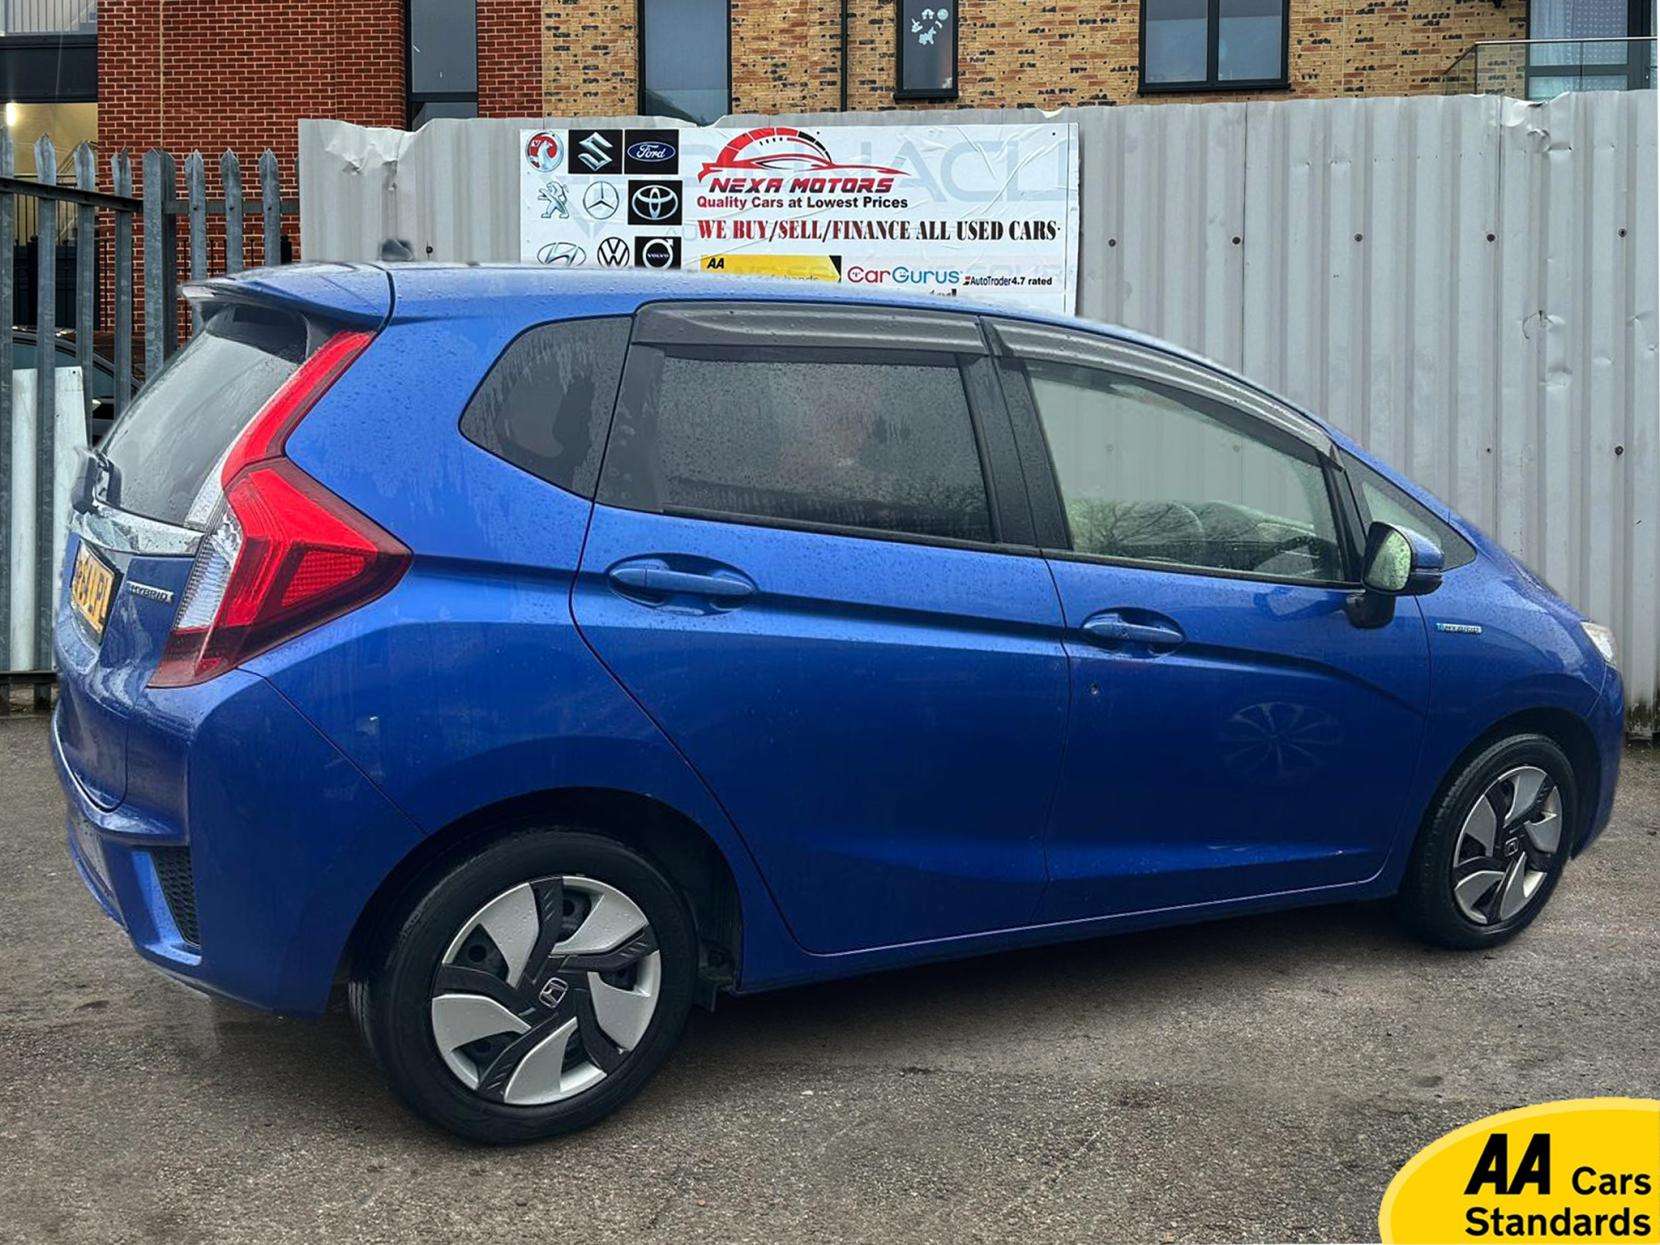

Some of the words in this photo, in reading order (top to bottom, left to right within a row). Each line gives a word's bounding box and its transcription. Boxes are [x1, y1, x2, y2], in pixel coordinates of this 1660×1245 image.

[636, 144, 666, 158] Ford
[708, 177, 784, 193] NEXA
[789, 177, 894, 193] MOTORS
[697, 195, 747, 210] Quality
[751, 195, 784, 208] Cars
[788, 196, 803, 208] at
[807, 196, 859, 208] Lowest
[863, 196, 908, 208] Prices
[698, 219, 727, 240] WE
[916, 220, 951, 240] ALL
[956, 220, 1004, 241] USED
[1008, 220, 1057, 241] CARS
[707, 257, 724, 269] AA
[847, 266, 960, 284] CarGurus
[1028, 277, 1053, 286] rated
